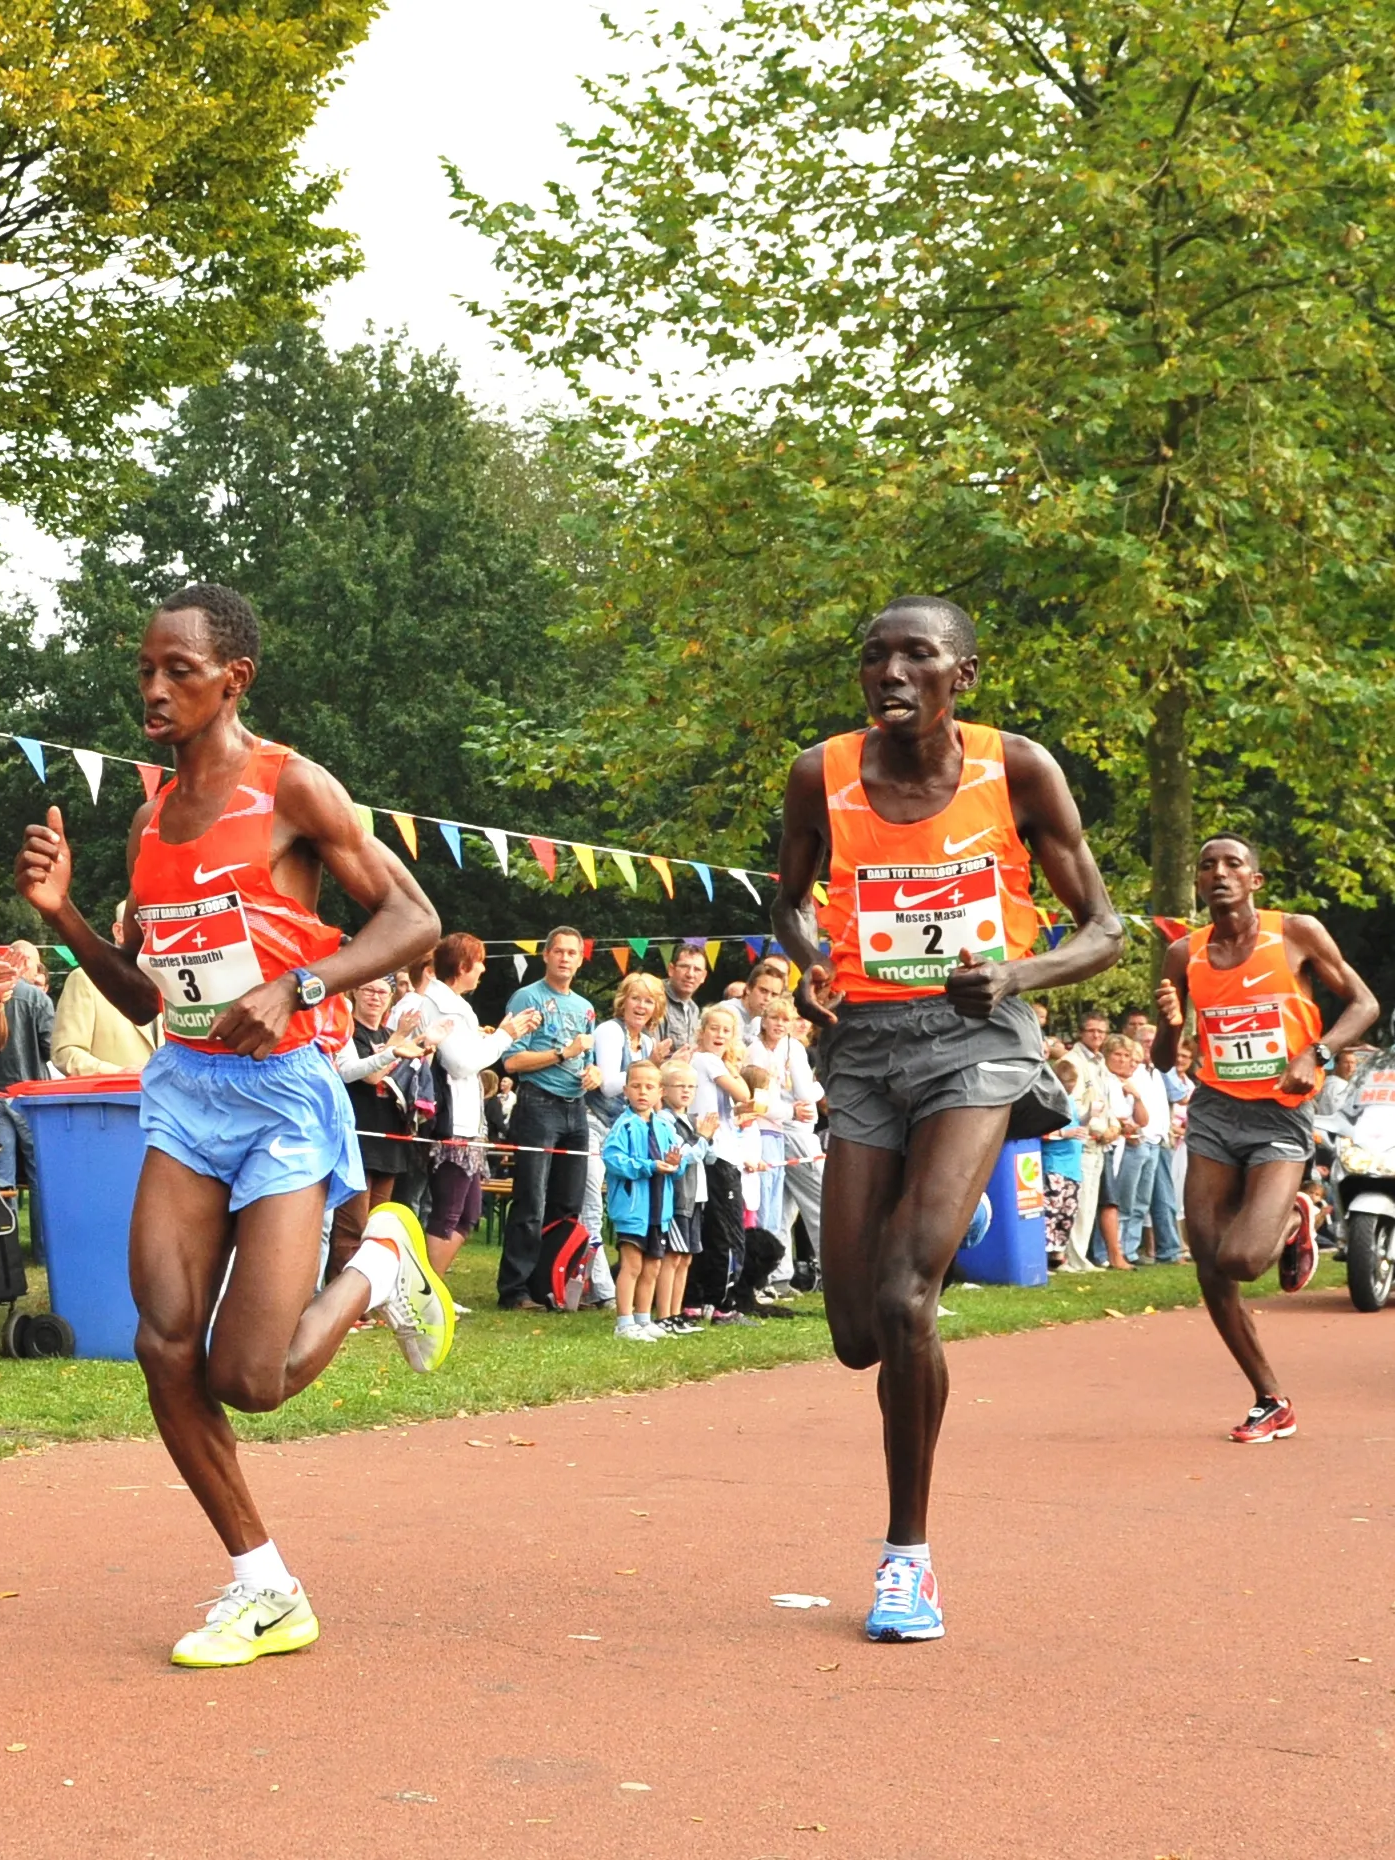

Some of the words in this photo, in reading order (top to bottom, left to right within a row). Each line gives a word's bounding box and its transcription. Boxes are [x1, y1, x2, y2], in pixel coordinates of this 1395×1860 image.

[867, 868, 890, 879] DAM
[891, 868, 911, 879] TOT
[911, 864, 959, 879] DAMLOOP
[960, 858, 987, 874] 2009
[197, 897, 229, 915] 2009
[895, 912, 932, 924] Moses
[921, 923, 945, 955] 2
[148, 955, 181, 969] Charles
[180, 949, 224, 967] Kamathi
[877, 957, 965, 980] maand
[177, 968, 202, 1003] 3
[168, 1008, 216, 1028] maand
[1232, 1040, 1253, 1060] 11
[1218, 1062, 1277, 1076] maandag
